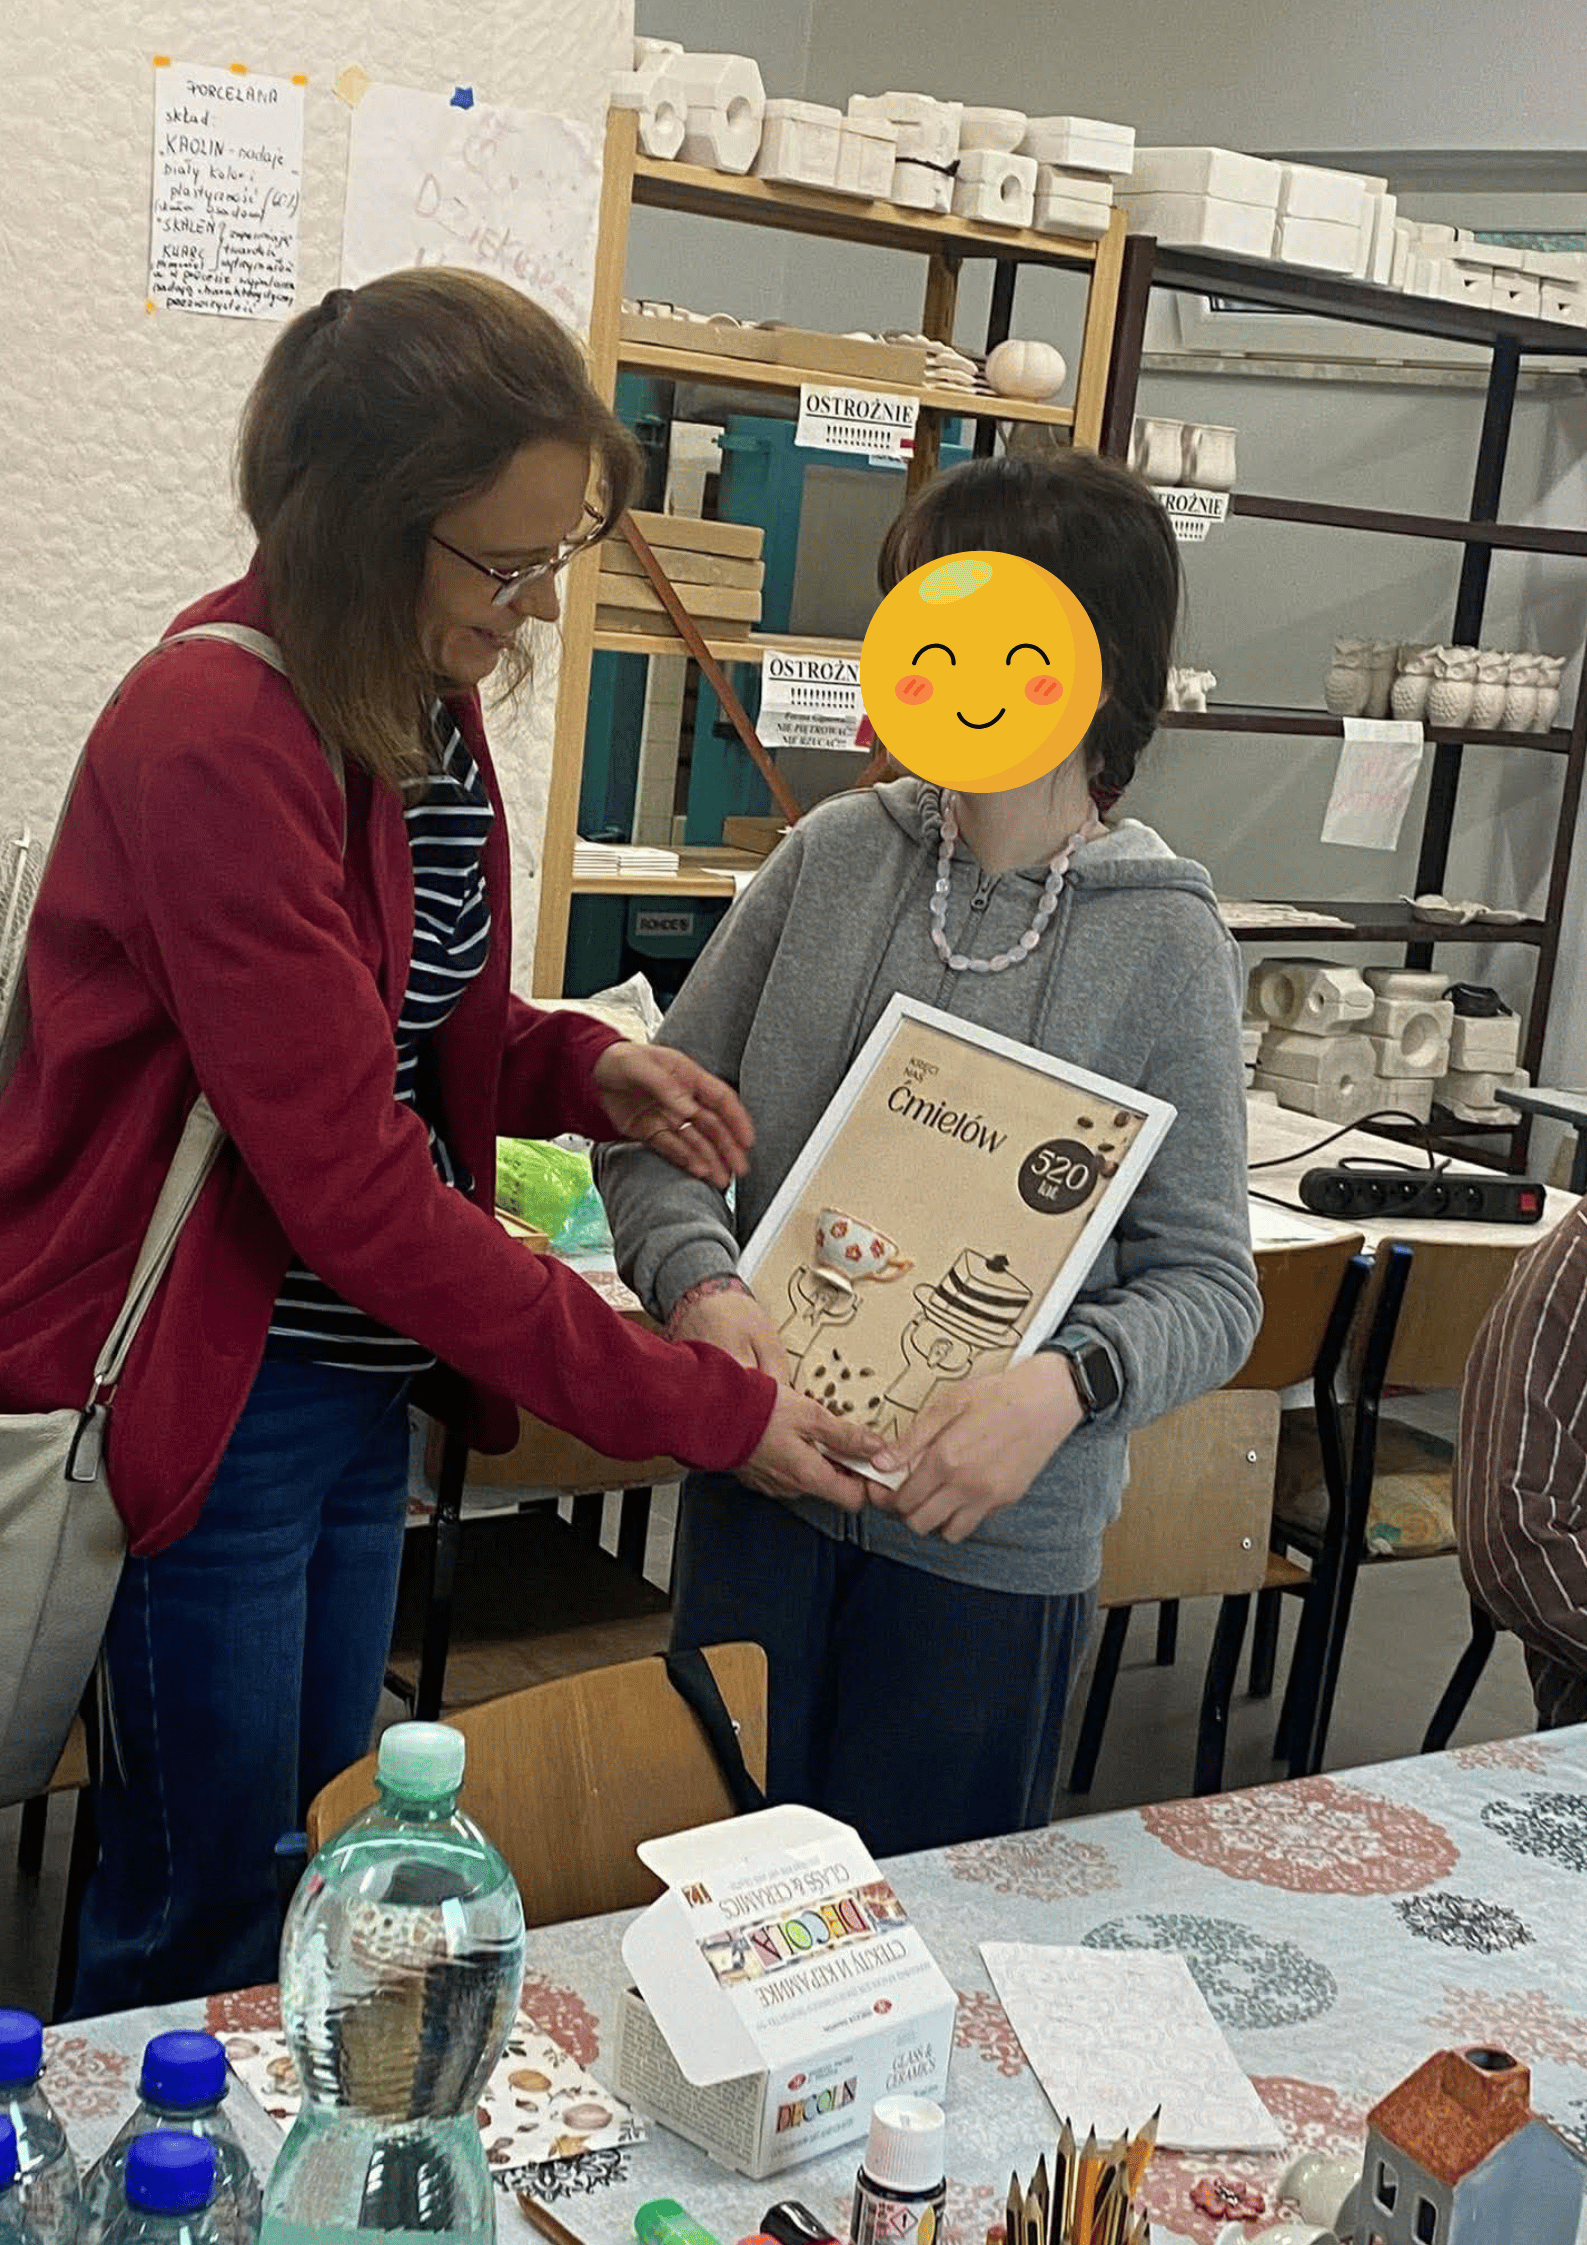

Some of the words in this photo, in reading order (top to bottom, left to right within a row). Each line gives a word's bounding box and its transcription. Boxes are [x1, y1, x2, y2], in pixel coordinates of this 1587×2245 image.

[186, 80, 278, 103] PORCELANA
[806, 393, 914, 424] OSTROŻNIE
[769, 658, 860, 682] OSTROŻN
[887, 1079, 1008, 1154] Ćmielów
[1030, 1148, 1089, 1190] 520
[750, 1897, 872, 1968] DECOLA
[776, 2075, 857, 2134] DECOLA
